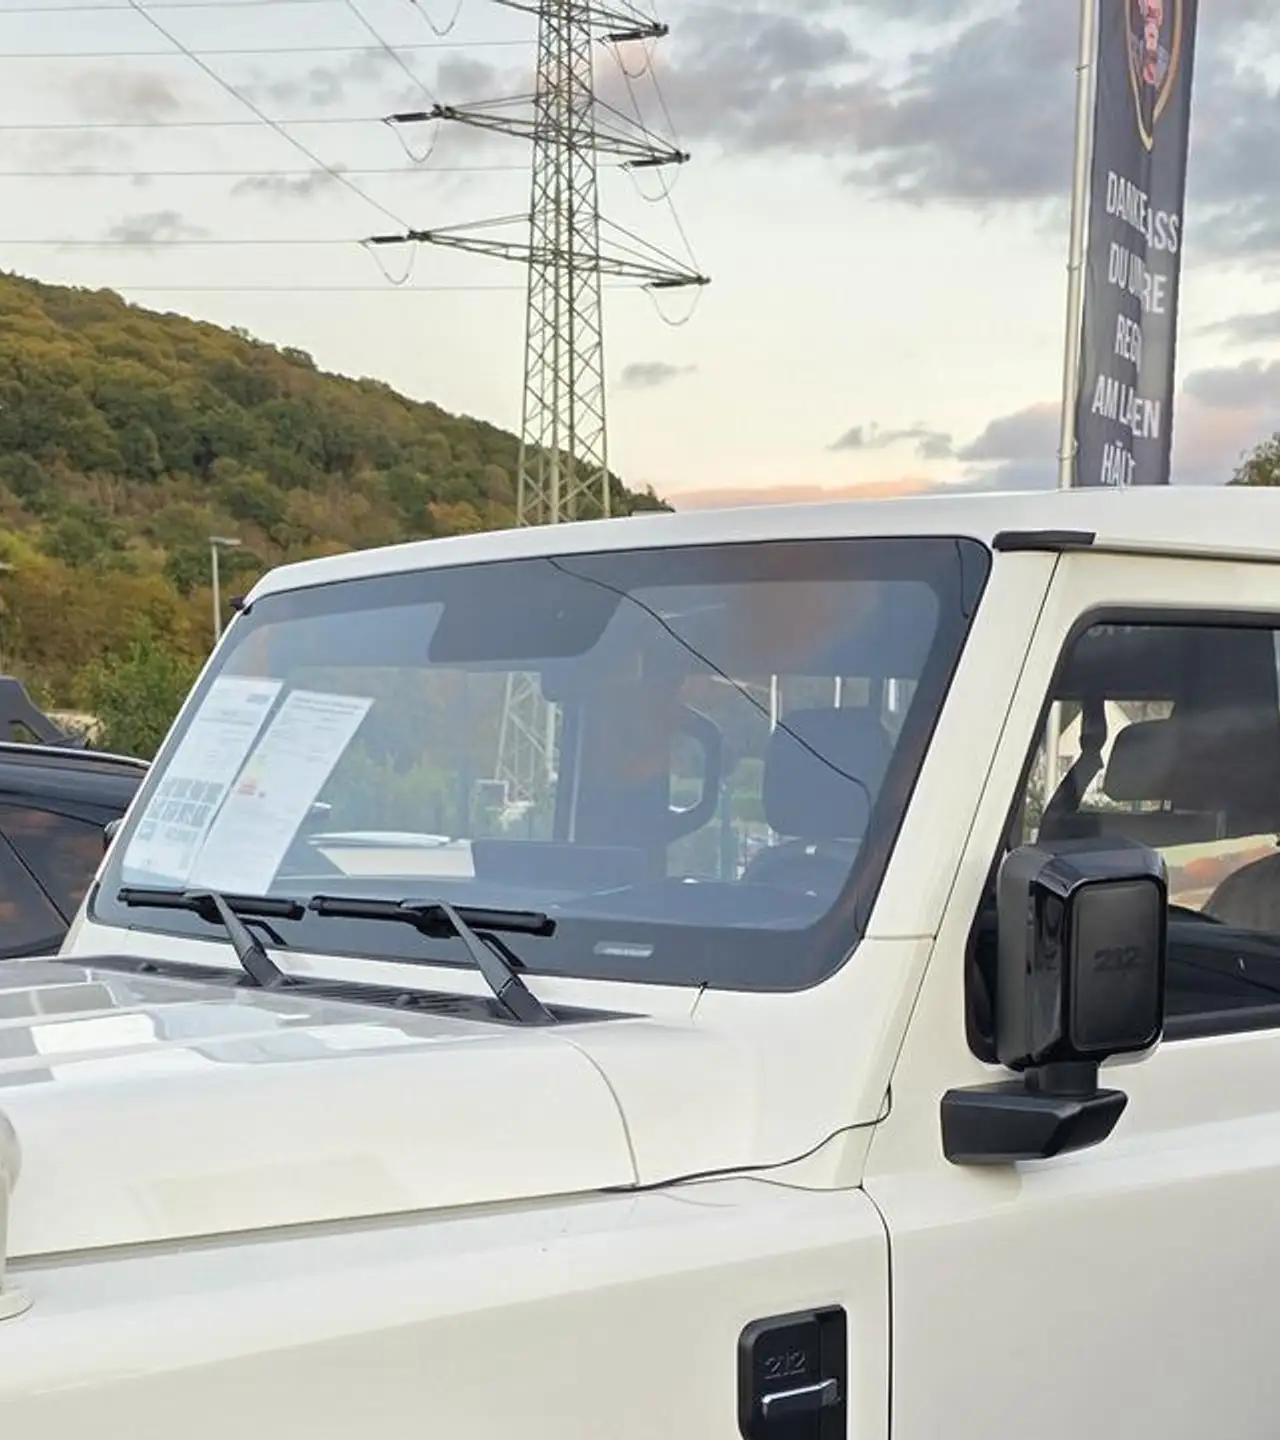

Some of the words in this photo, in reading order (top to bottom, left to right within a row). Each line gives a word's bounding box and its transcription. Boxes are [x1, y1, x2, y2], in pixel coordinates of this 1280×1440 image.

[1109, 242, 1129, 289] DU
[1092, 374, 1119, 420] AM
[764, 1350, 806, 1380] 212
